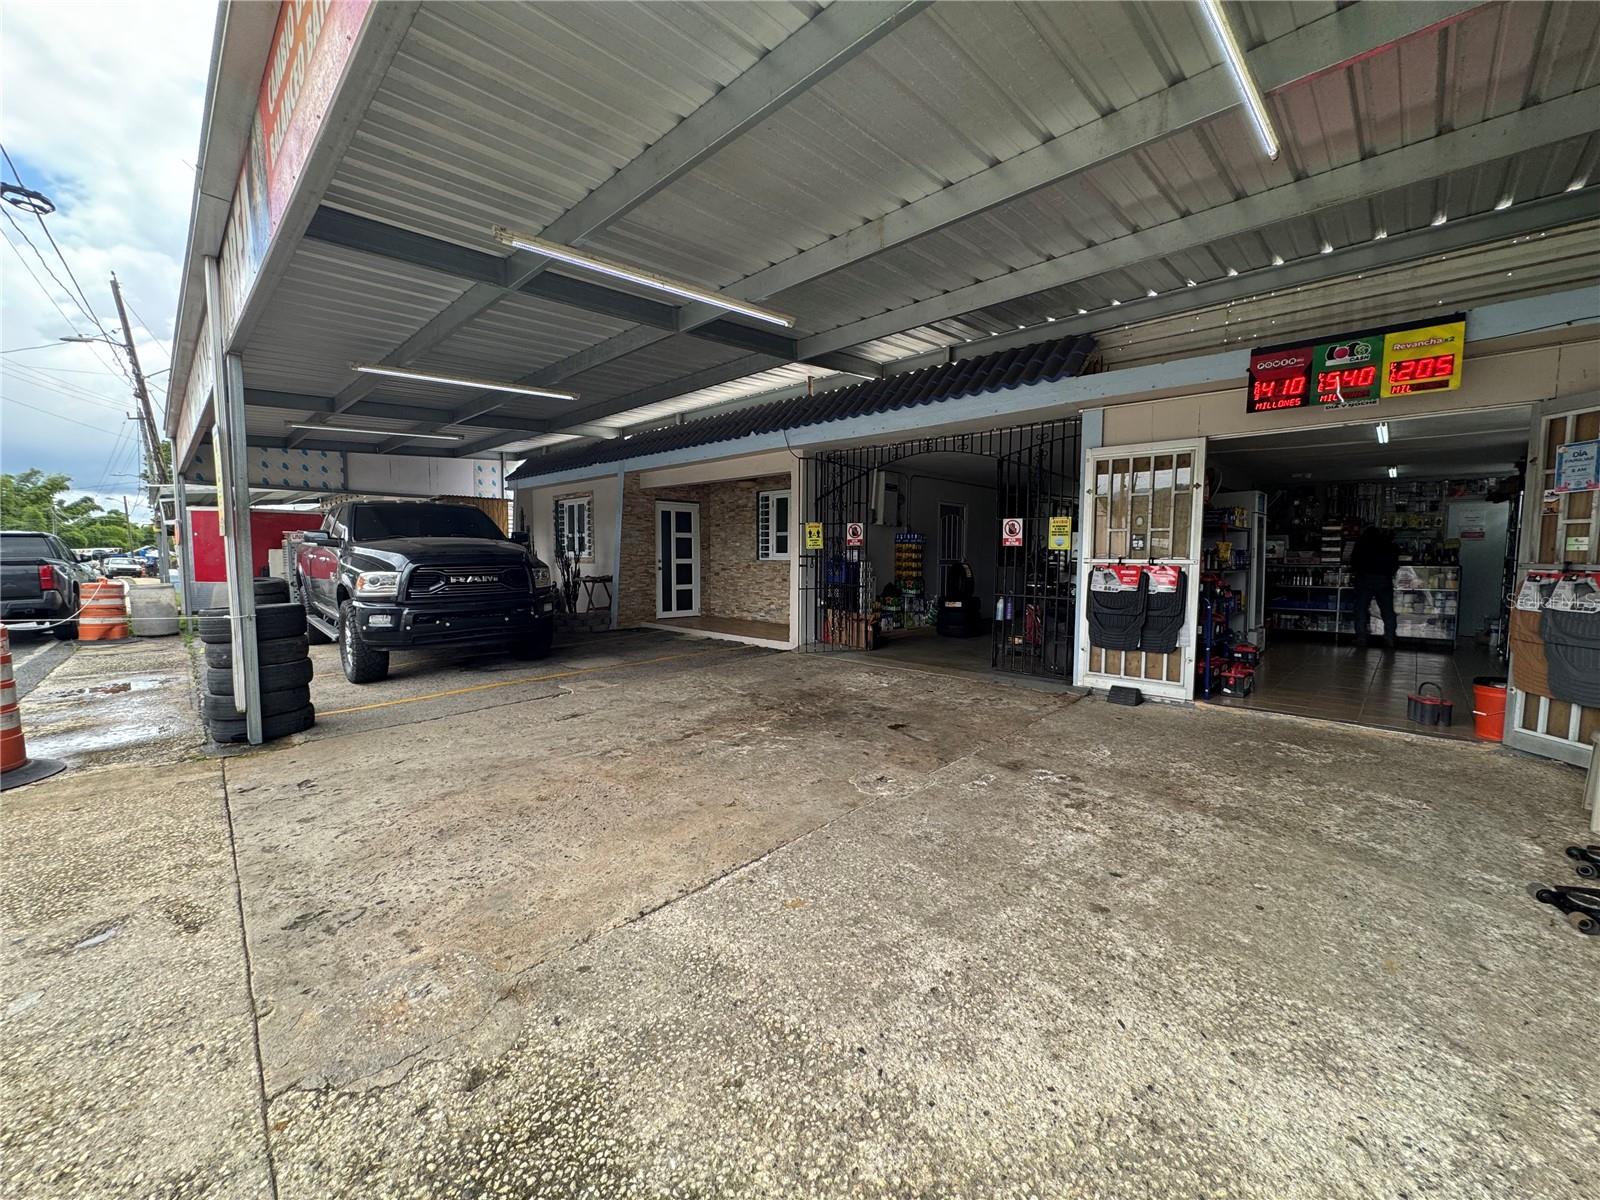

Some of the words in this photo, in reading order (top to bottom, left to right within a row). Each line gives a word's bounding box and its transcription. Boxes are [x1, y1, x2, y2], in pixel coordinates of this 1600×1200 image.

[268, 4, 295, 114] CAMBIO
[270, 41, 305, 168] BALANCEO
[1393, 336, 1444, 351] Revancha
[1325, 366, 1377, 390] 540
[1398, 355, 1453, 380] 205
[1261, 376, 1306, 397] 410
[1391, 384, 1412, 394] MIL
[1255, 398, 1301, 410] MILLONES
[1320, 393, 1338, 403] MIL
